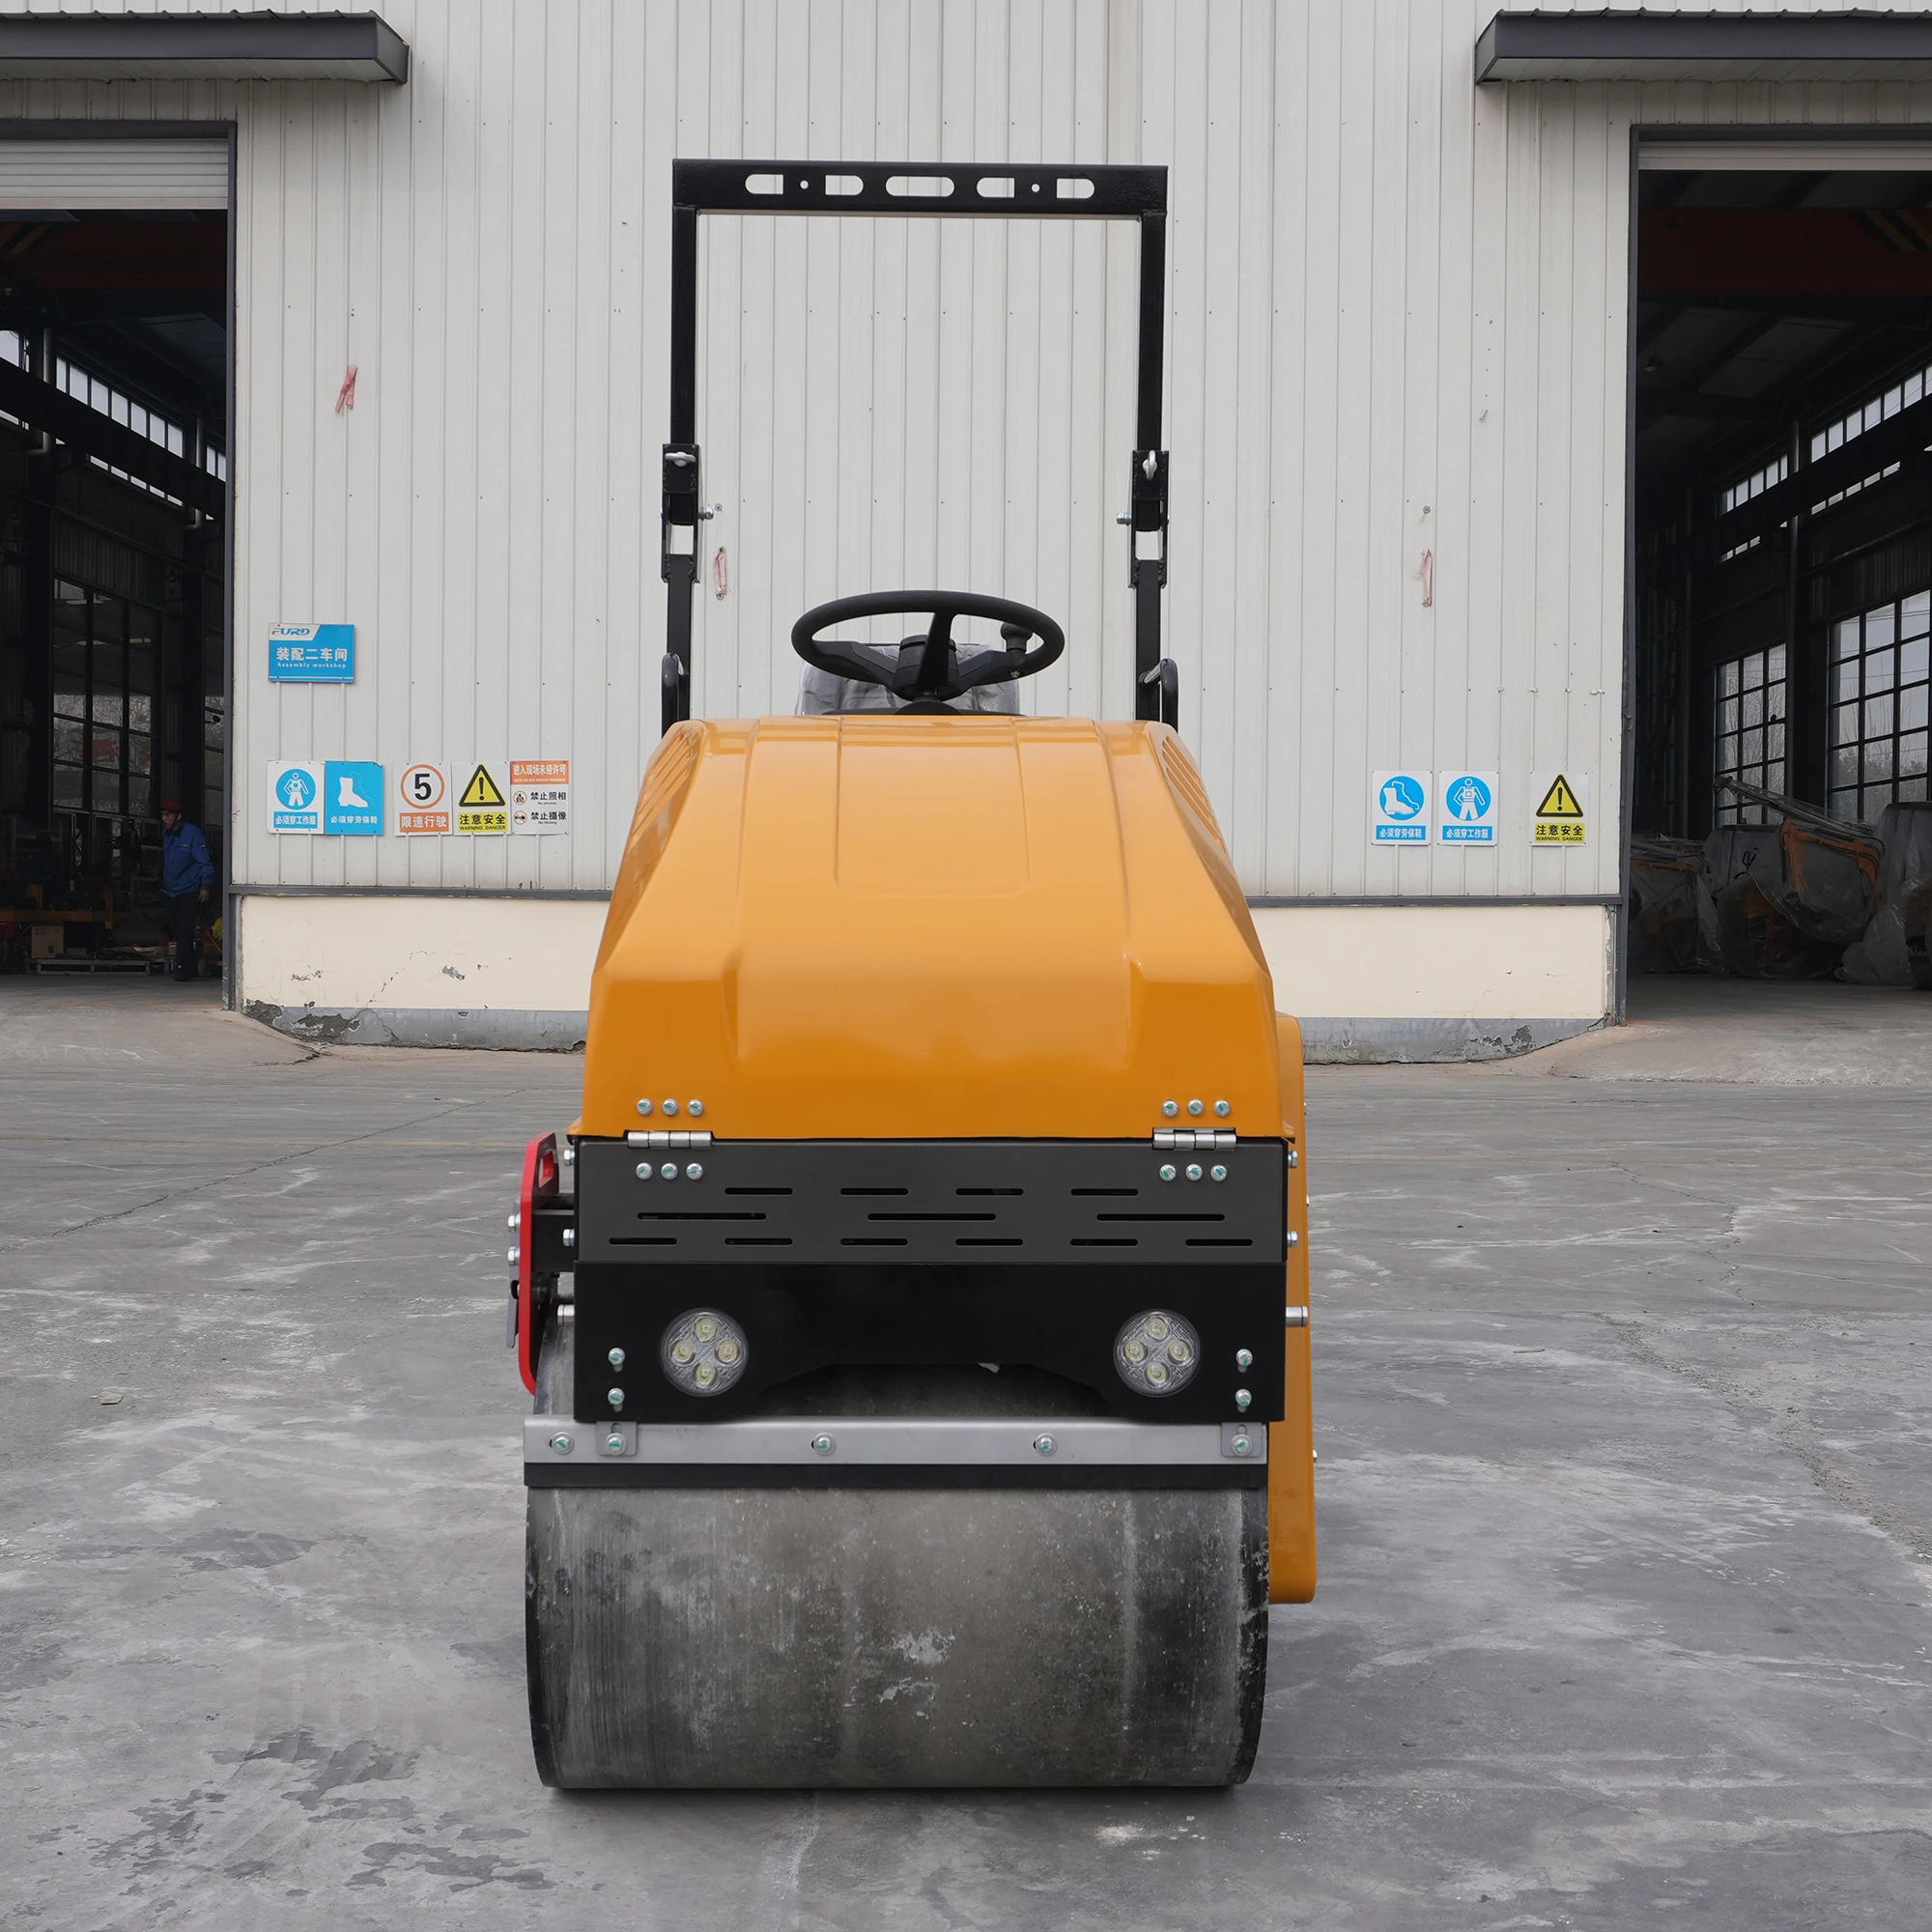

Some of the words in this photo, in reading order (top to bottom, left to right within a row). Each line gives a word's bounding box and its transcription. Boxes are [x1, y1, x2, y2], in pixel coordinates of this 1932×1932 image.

[276, 647, 348, 661] 装配二车间
[513, 764, 566, 775] 进入现场未经许可
[414, 773, 431, 800] 5
[530, 792, 566, 800] 禁止照相
[275, 816, 316, 824] 必须穿工作服
[330, 816, 378, 824] 必须穿劳保鞋
[459, 814, 505, 825] 注意安全
[531, 811, 567, 821] 禁止摄像
[401, 816, 447, 828] 限速行驶
[1380, 828, 1422, 838] 必须穿劳保鞋
[1446, 829, 1488, 838] 必须穿工作服
[1536, 825, 1583, 836] 注意安全
